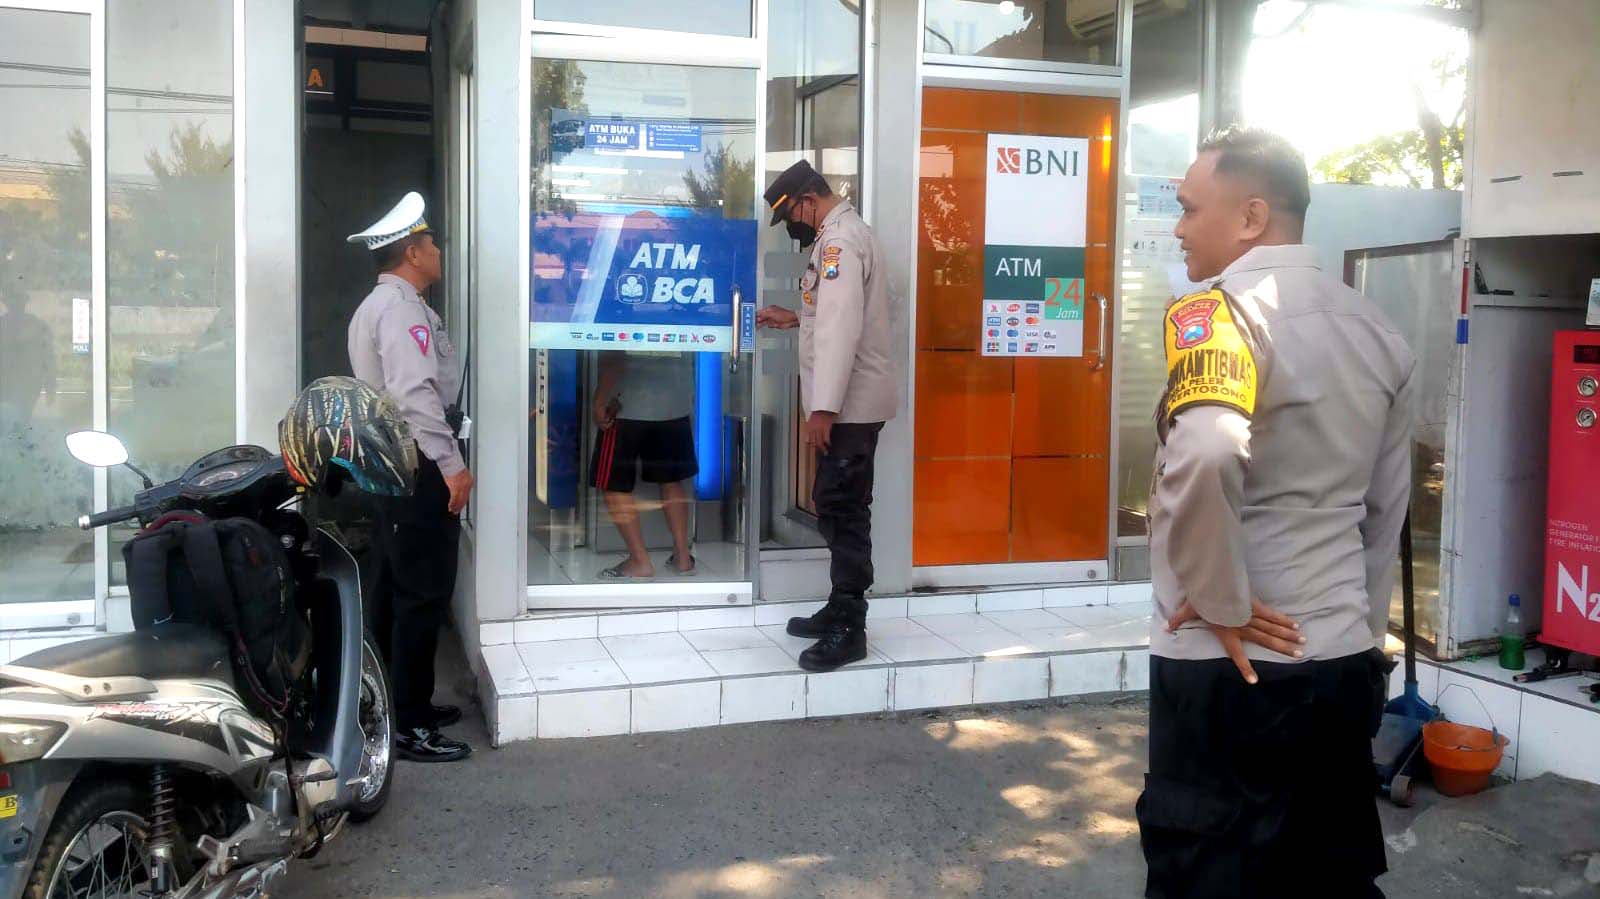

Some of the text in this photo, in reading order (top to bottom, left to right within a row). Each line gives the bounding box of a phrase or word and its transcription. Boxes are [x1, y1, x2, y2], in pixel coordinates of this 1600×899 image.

[589, 124, 635, 135] ATM BUKA
[596, 135, 628, 145] 24 JAM
[1025, 148, 1079, 177] BNI
[628, 242, 701, 270] ATM
[995, 257, 1042, 277] ATM
[651, 276, 715, 304] BCA
[1045, 277, 1082, 306] 24
[1056, 307, 1079, 319] Jam
